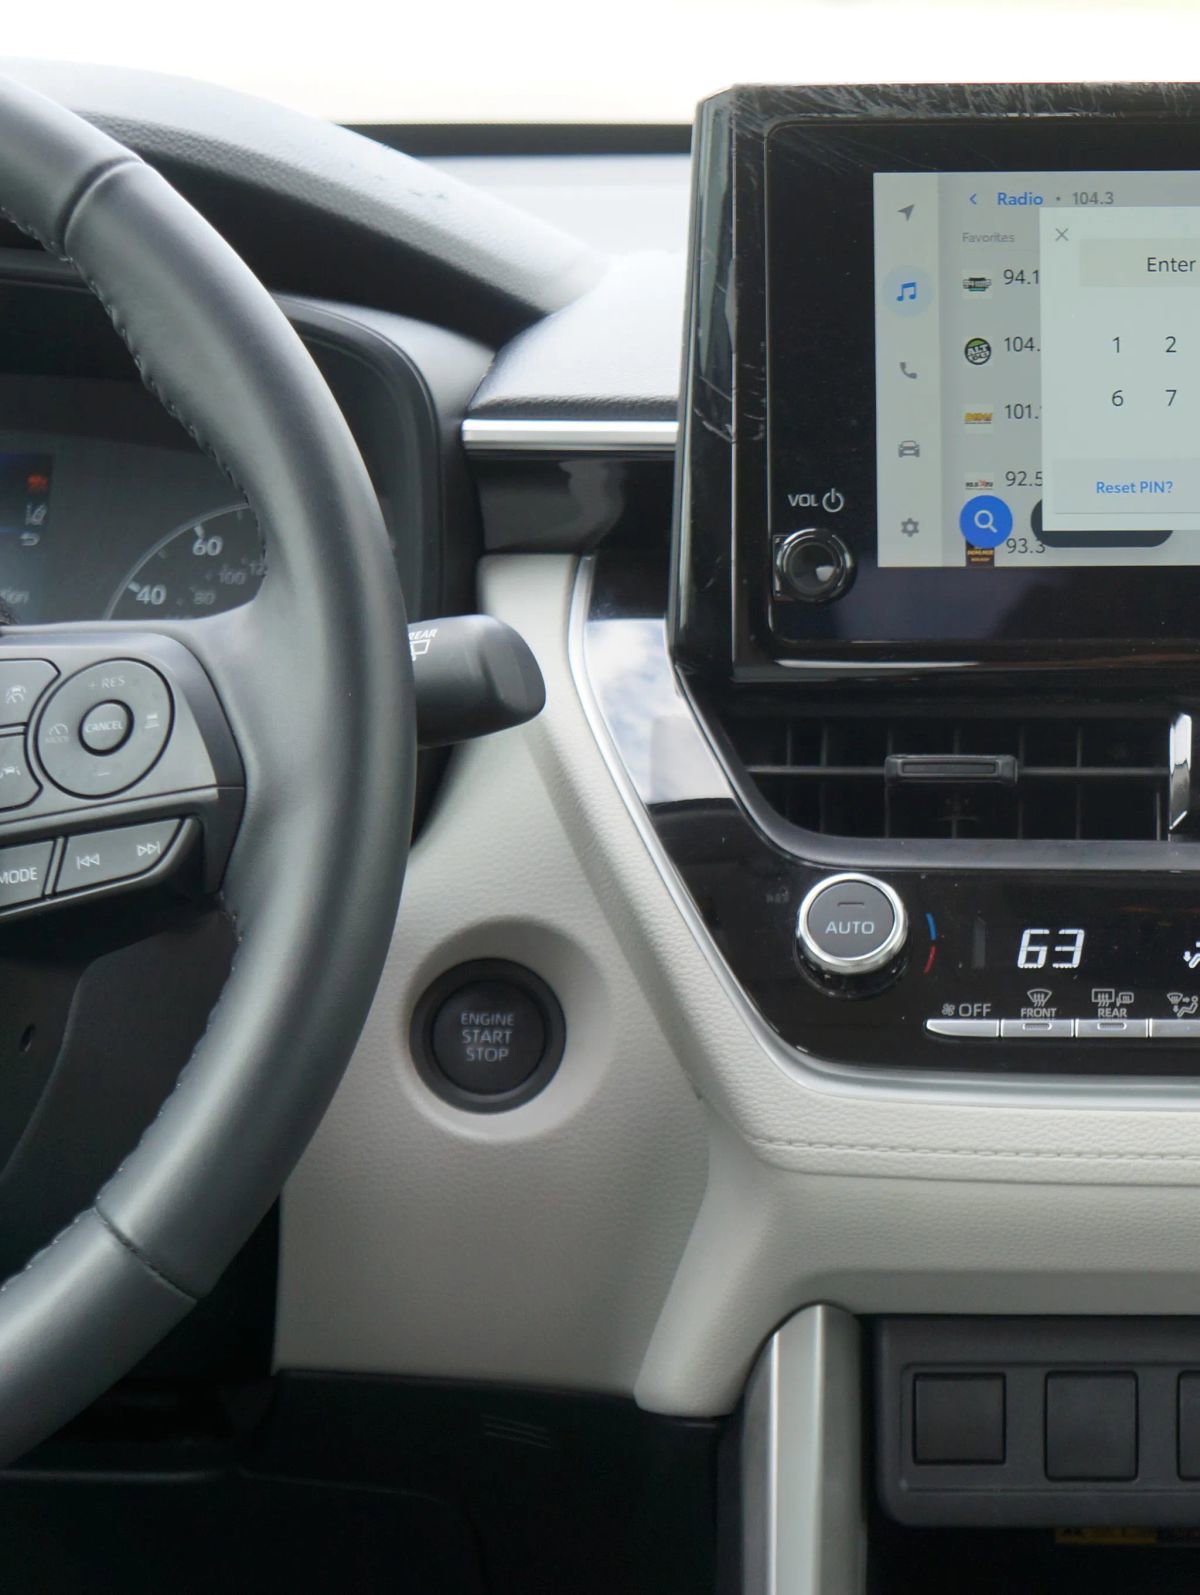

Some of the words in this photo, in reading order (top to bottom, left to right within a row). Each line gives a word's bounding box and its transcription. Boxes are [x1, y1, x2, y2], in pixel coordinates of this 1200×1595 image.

[997, 191, 1044, 206] Radio
[1072, 191, 1115, 206] 104.3
[961, 231, 1015, 243] Favorites
[1147, 256, 1197, 273] Enter
[1003, 268, 1039, 285] 94.1
[1112, 336, 1120, 353] 1
[1165, 336, 1177, 353] 2
[1111, 389, 1124, 407] 6
[1165, 389, 1177, 406] 7
[1004, 403, 1042, 420] 101.
[1096, 480, 1137, 494] Reset
[1139, 480, 1174, 494] PIN?
[787, 493, 819, 507] VOL
[193, 535, 223, 556] 60
[136, 583, 167, 606] 40
[84, 720, 124, 733] CANCEL
[0, 866, 38, 885] MODE
[825, 920, 875, 935] AUTO
[1017, 928, 1085, 969] 63
[958, 1003, 992, 1018] OFF
[1020, 1007, 1057, 1018] FRONT
[1097, 1007, 1128, 1018] REAR
[460, 1012, 515, 1026] ENGINE
[461, 1028, 513, 1045] START
[465, 1046, 510, 1062] STOP
